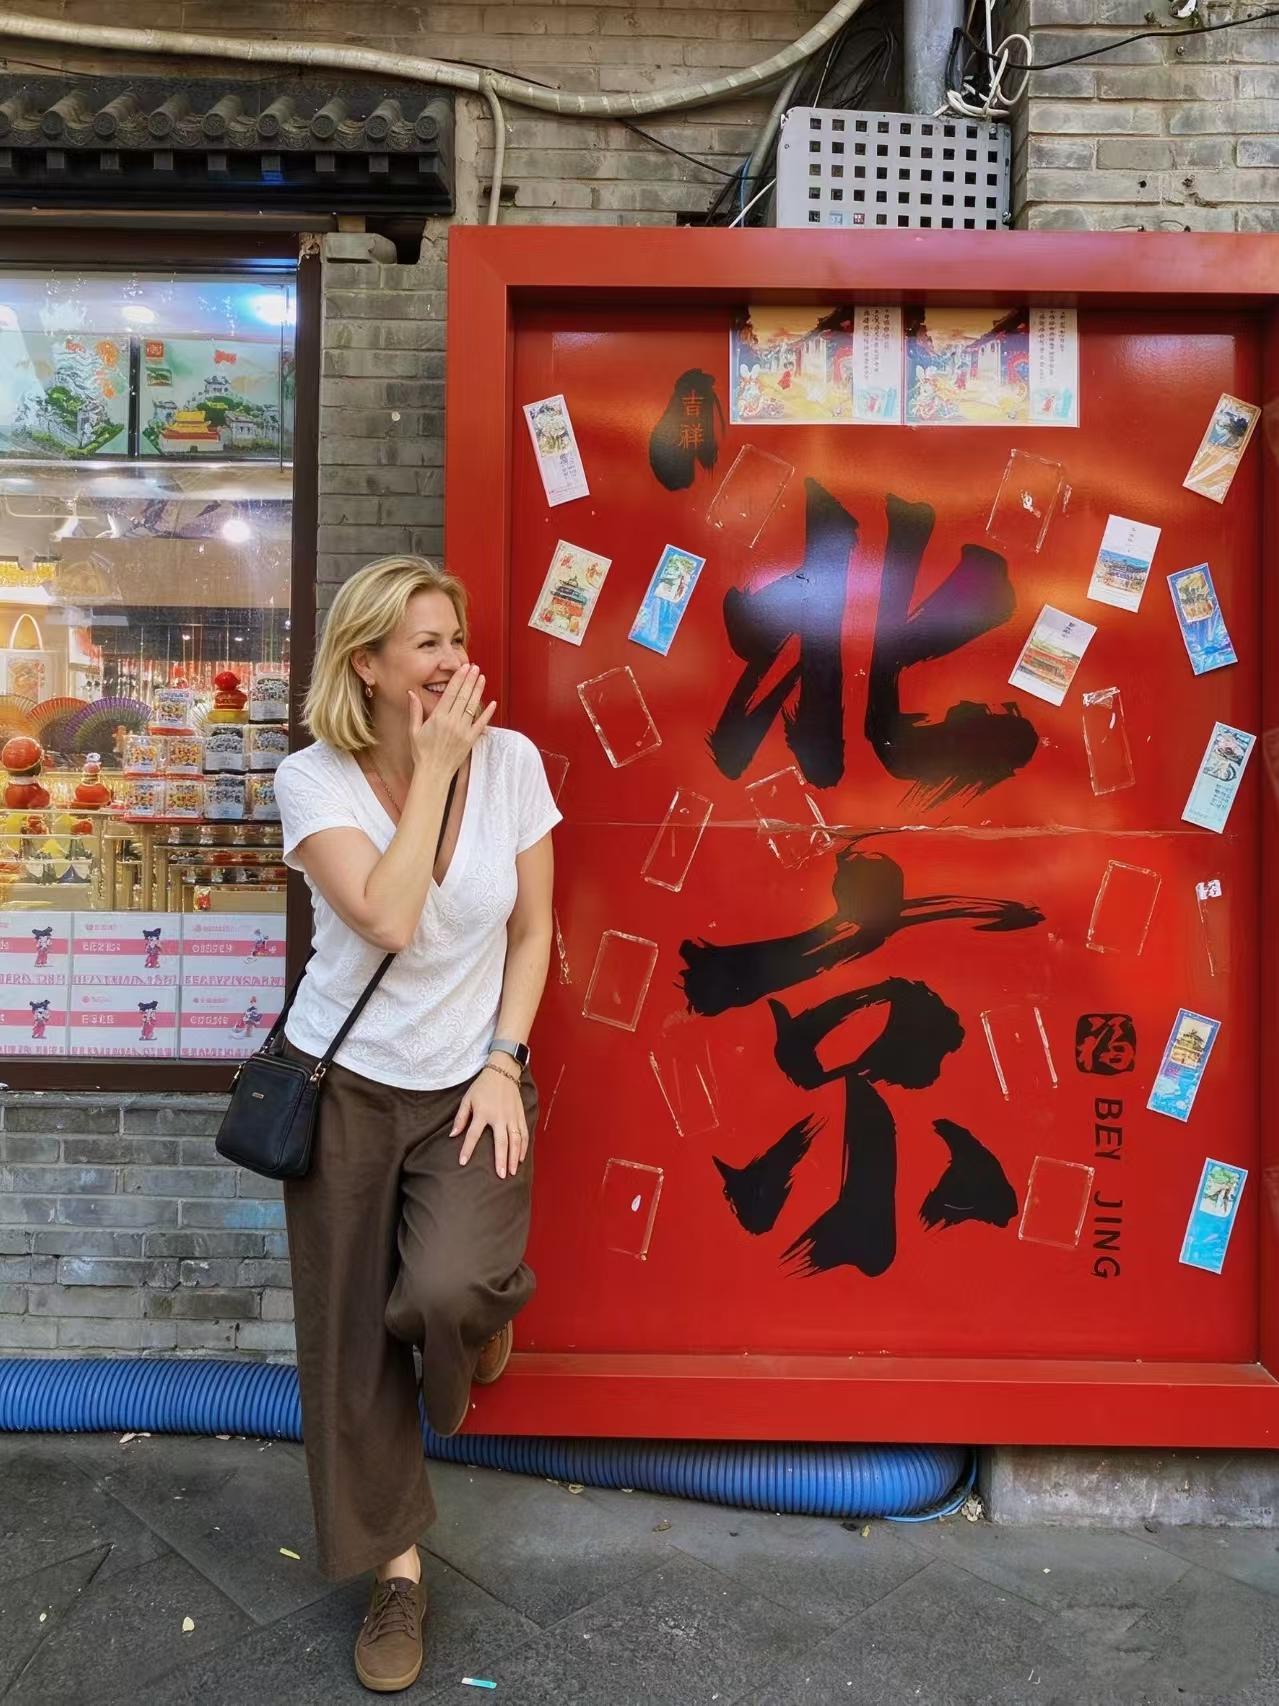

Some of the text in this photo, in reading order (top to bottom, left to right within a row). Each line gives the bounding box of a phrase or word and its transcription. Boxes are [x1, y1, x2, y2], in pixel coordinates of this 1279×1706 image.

[677, 389, 707, 450] 吉祥
[680, 476, 1046, 1278] 北京
[1076, 1014, 1136, 1075] 福
[1093, 1190, 1123, 1279] JING
